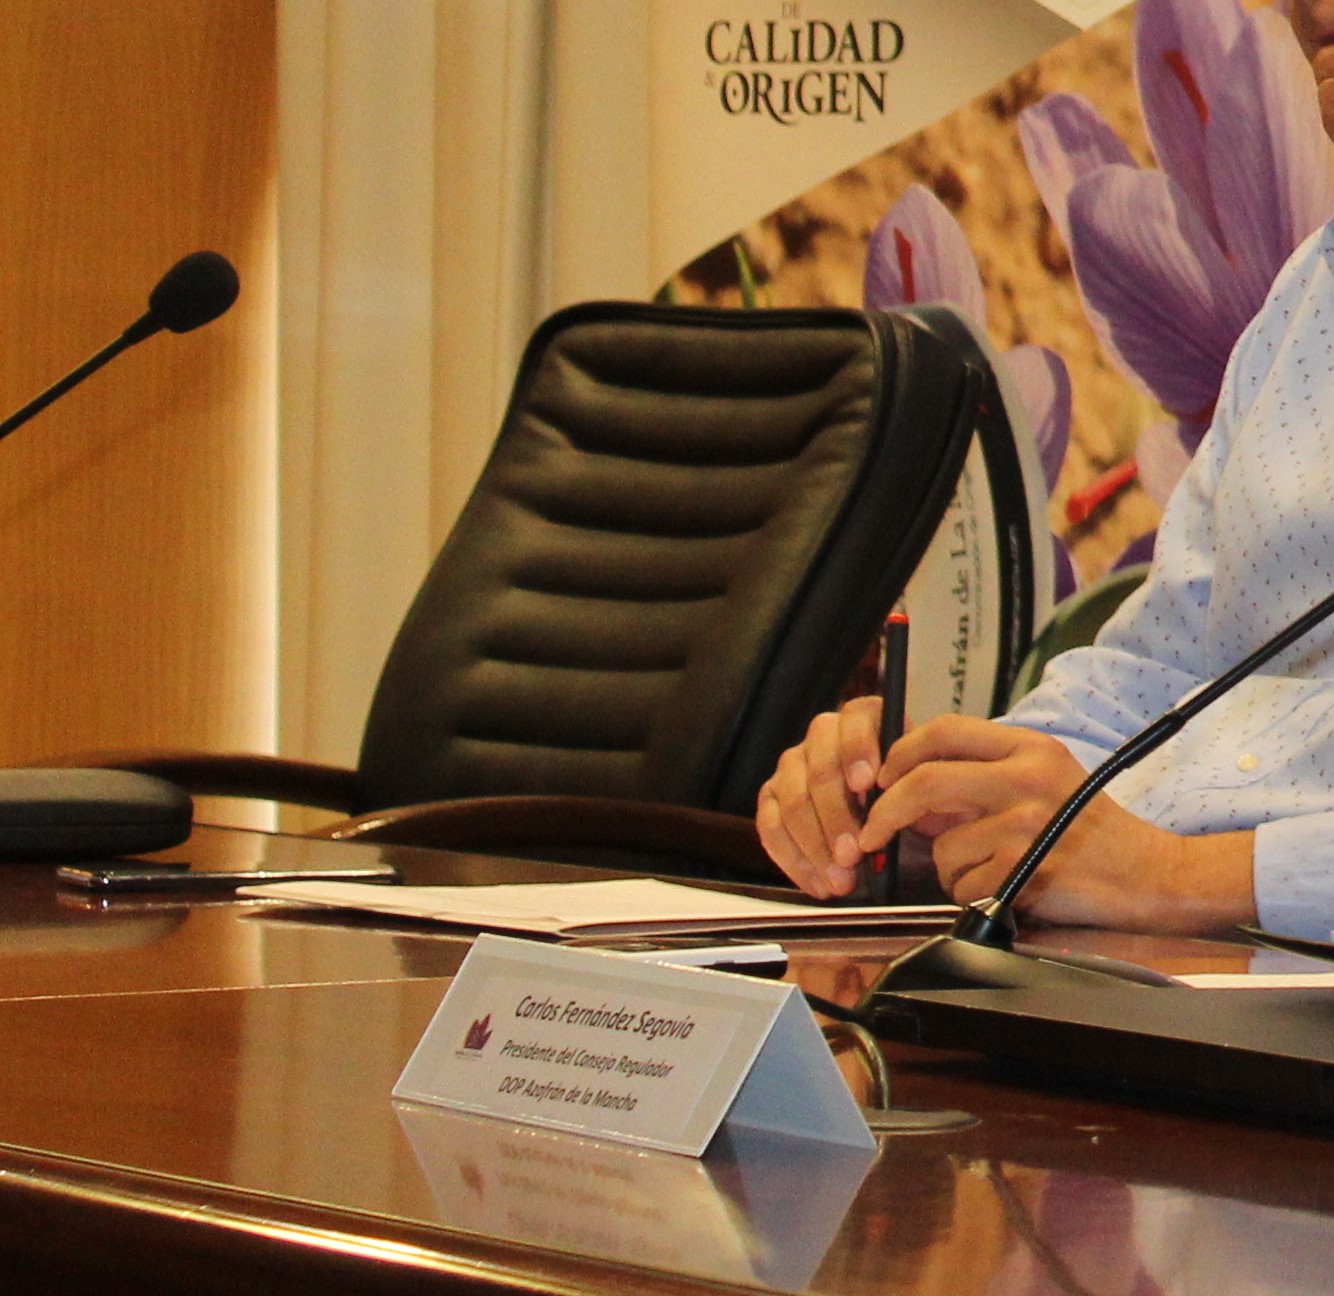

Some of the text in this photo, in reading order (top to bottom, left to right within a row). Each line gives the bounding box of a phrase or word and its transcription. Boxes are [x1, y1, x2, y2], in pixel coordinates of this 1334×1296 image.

[515, 995, 696, 1041] Carlos Fernández Segovia
[500, 1040, 555, 1063] Presidente
[556, 1045, 575, 1065] del
[574, 1049, 616, 1074] Consejo
[615, 1055, 674, 1079] Regulador
[498, 1076, 638, 1112] DOP Azafrán de la Mancha
